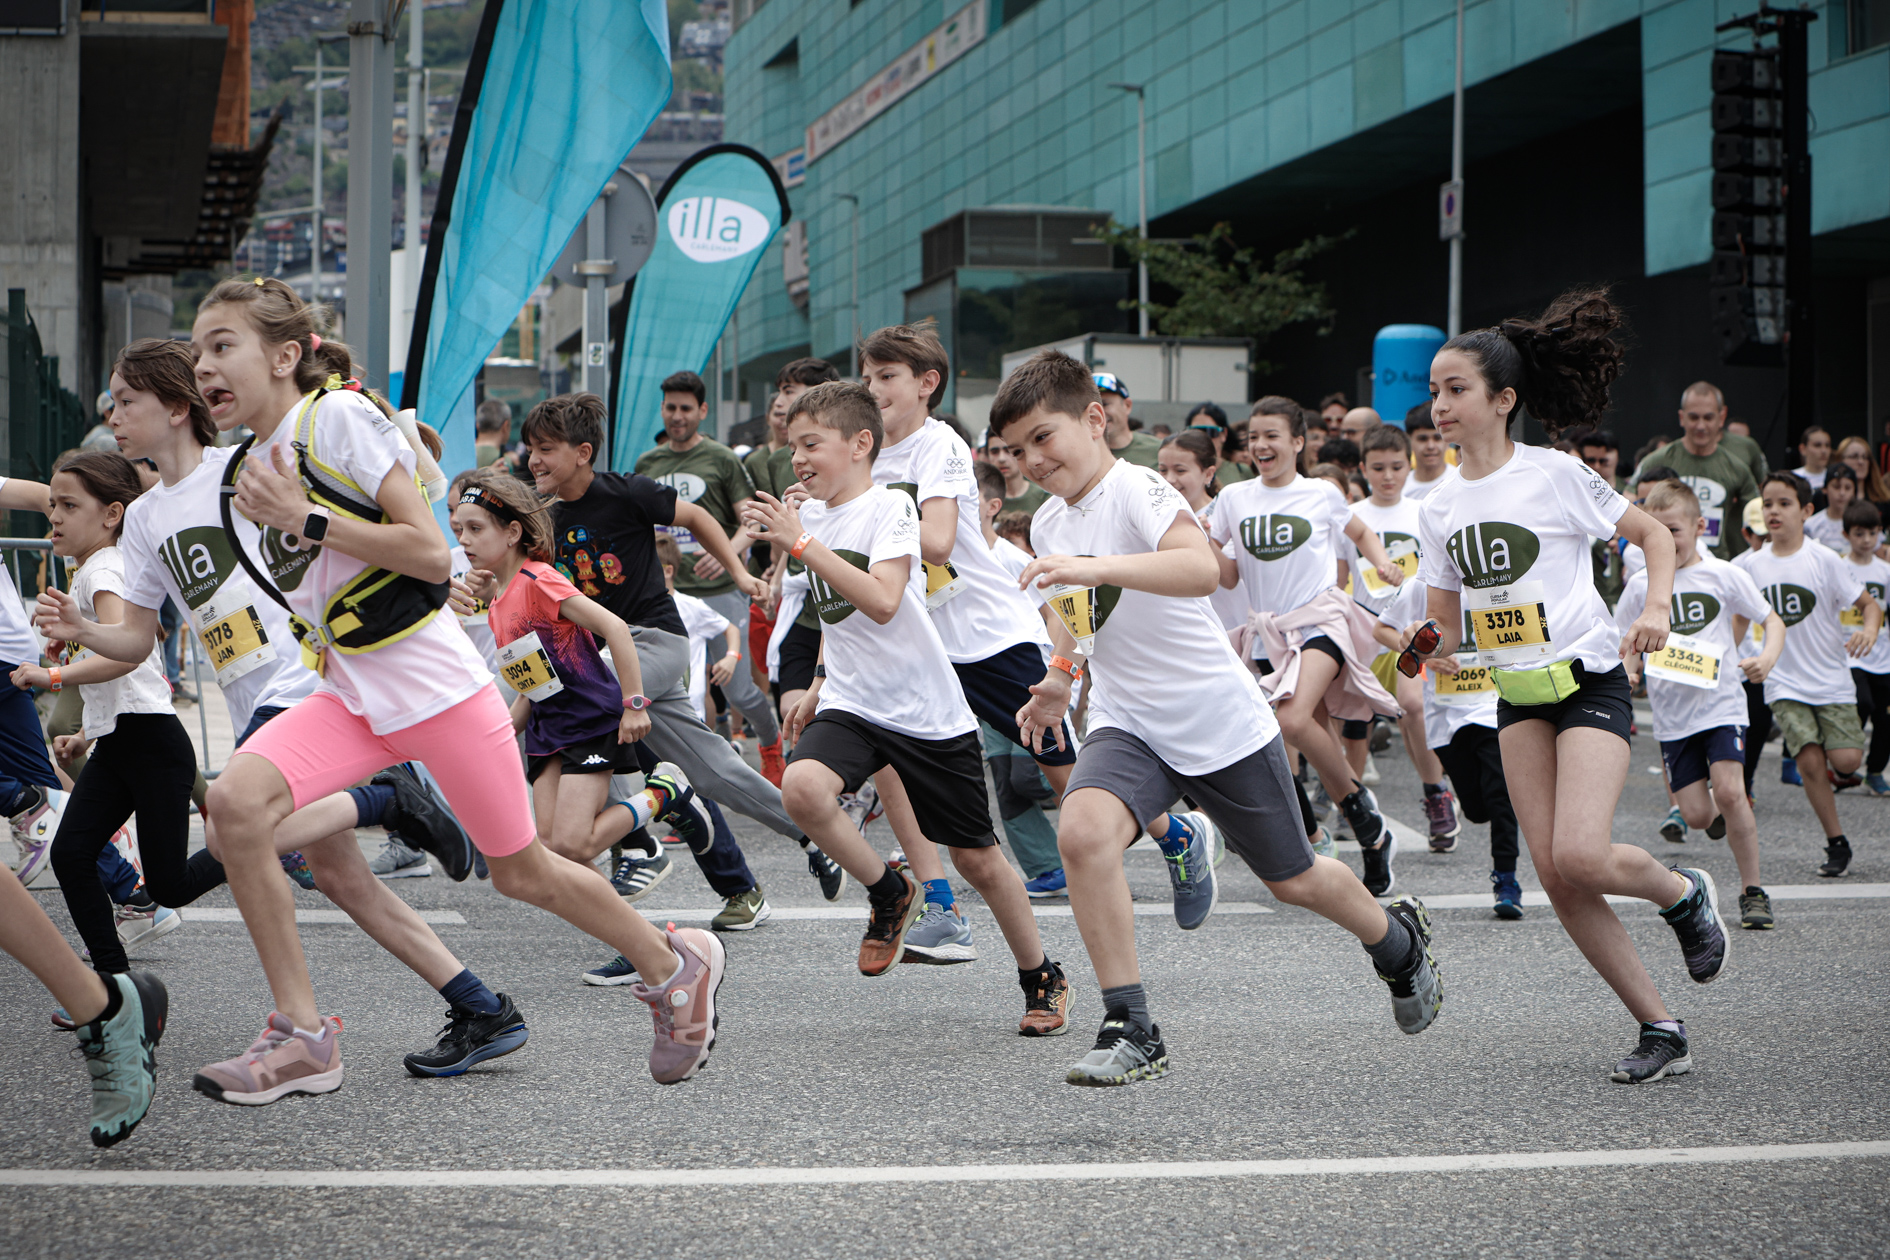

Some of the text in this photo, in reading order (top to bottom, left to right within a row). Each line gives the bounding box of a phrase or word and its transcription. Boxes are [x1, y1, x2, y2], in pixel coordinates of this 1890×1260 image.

[679, 197, 742, 243] illa
[1245, 513, 1294, 548] illa
[1256, 544, 1293, 554] CARLEMANY
[1450, 523, 1511, 578] illa
[1484, 609, 1525, 630] 3378
[1496, 631, 1524, 645] LAIA
[217, 645, 236, 664] JAN
[1667, 647, 1704, 666] 3342
[505, 659, 532, 680] 3094
[1663, 659, 1704, 675] CLÉONTIN
[517, 677, 537, 691] CINTA
[1456, 682, 1483, 692] ALEIX
